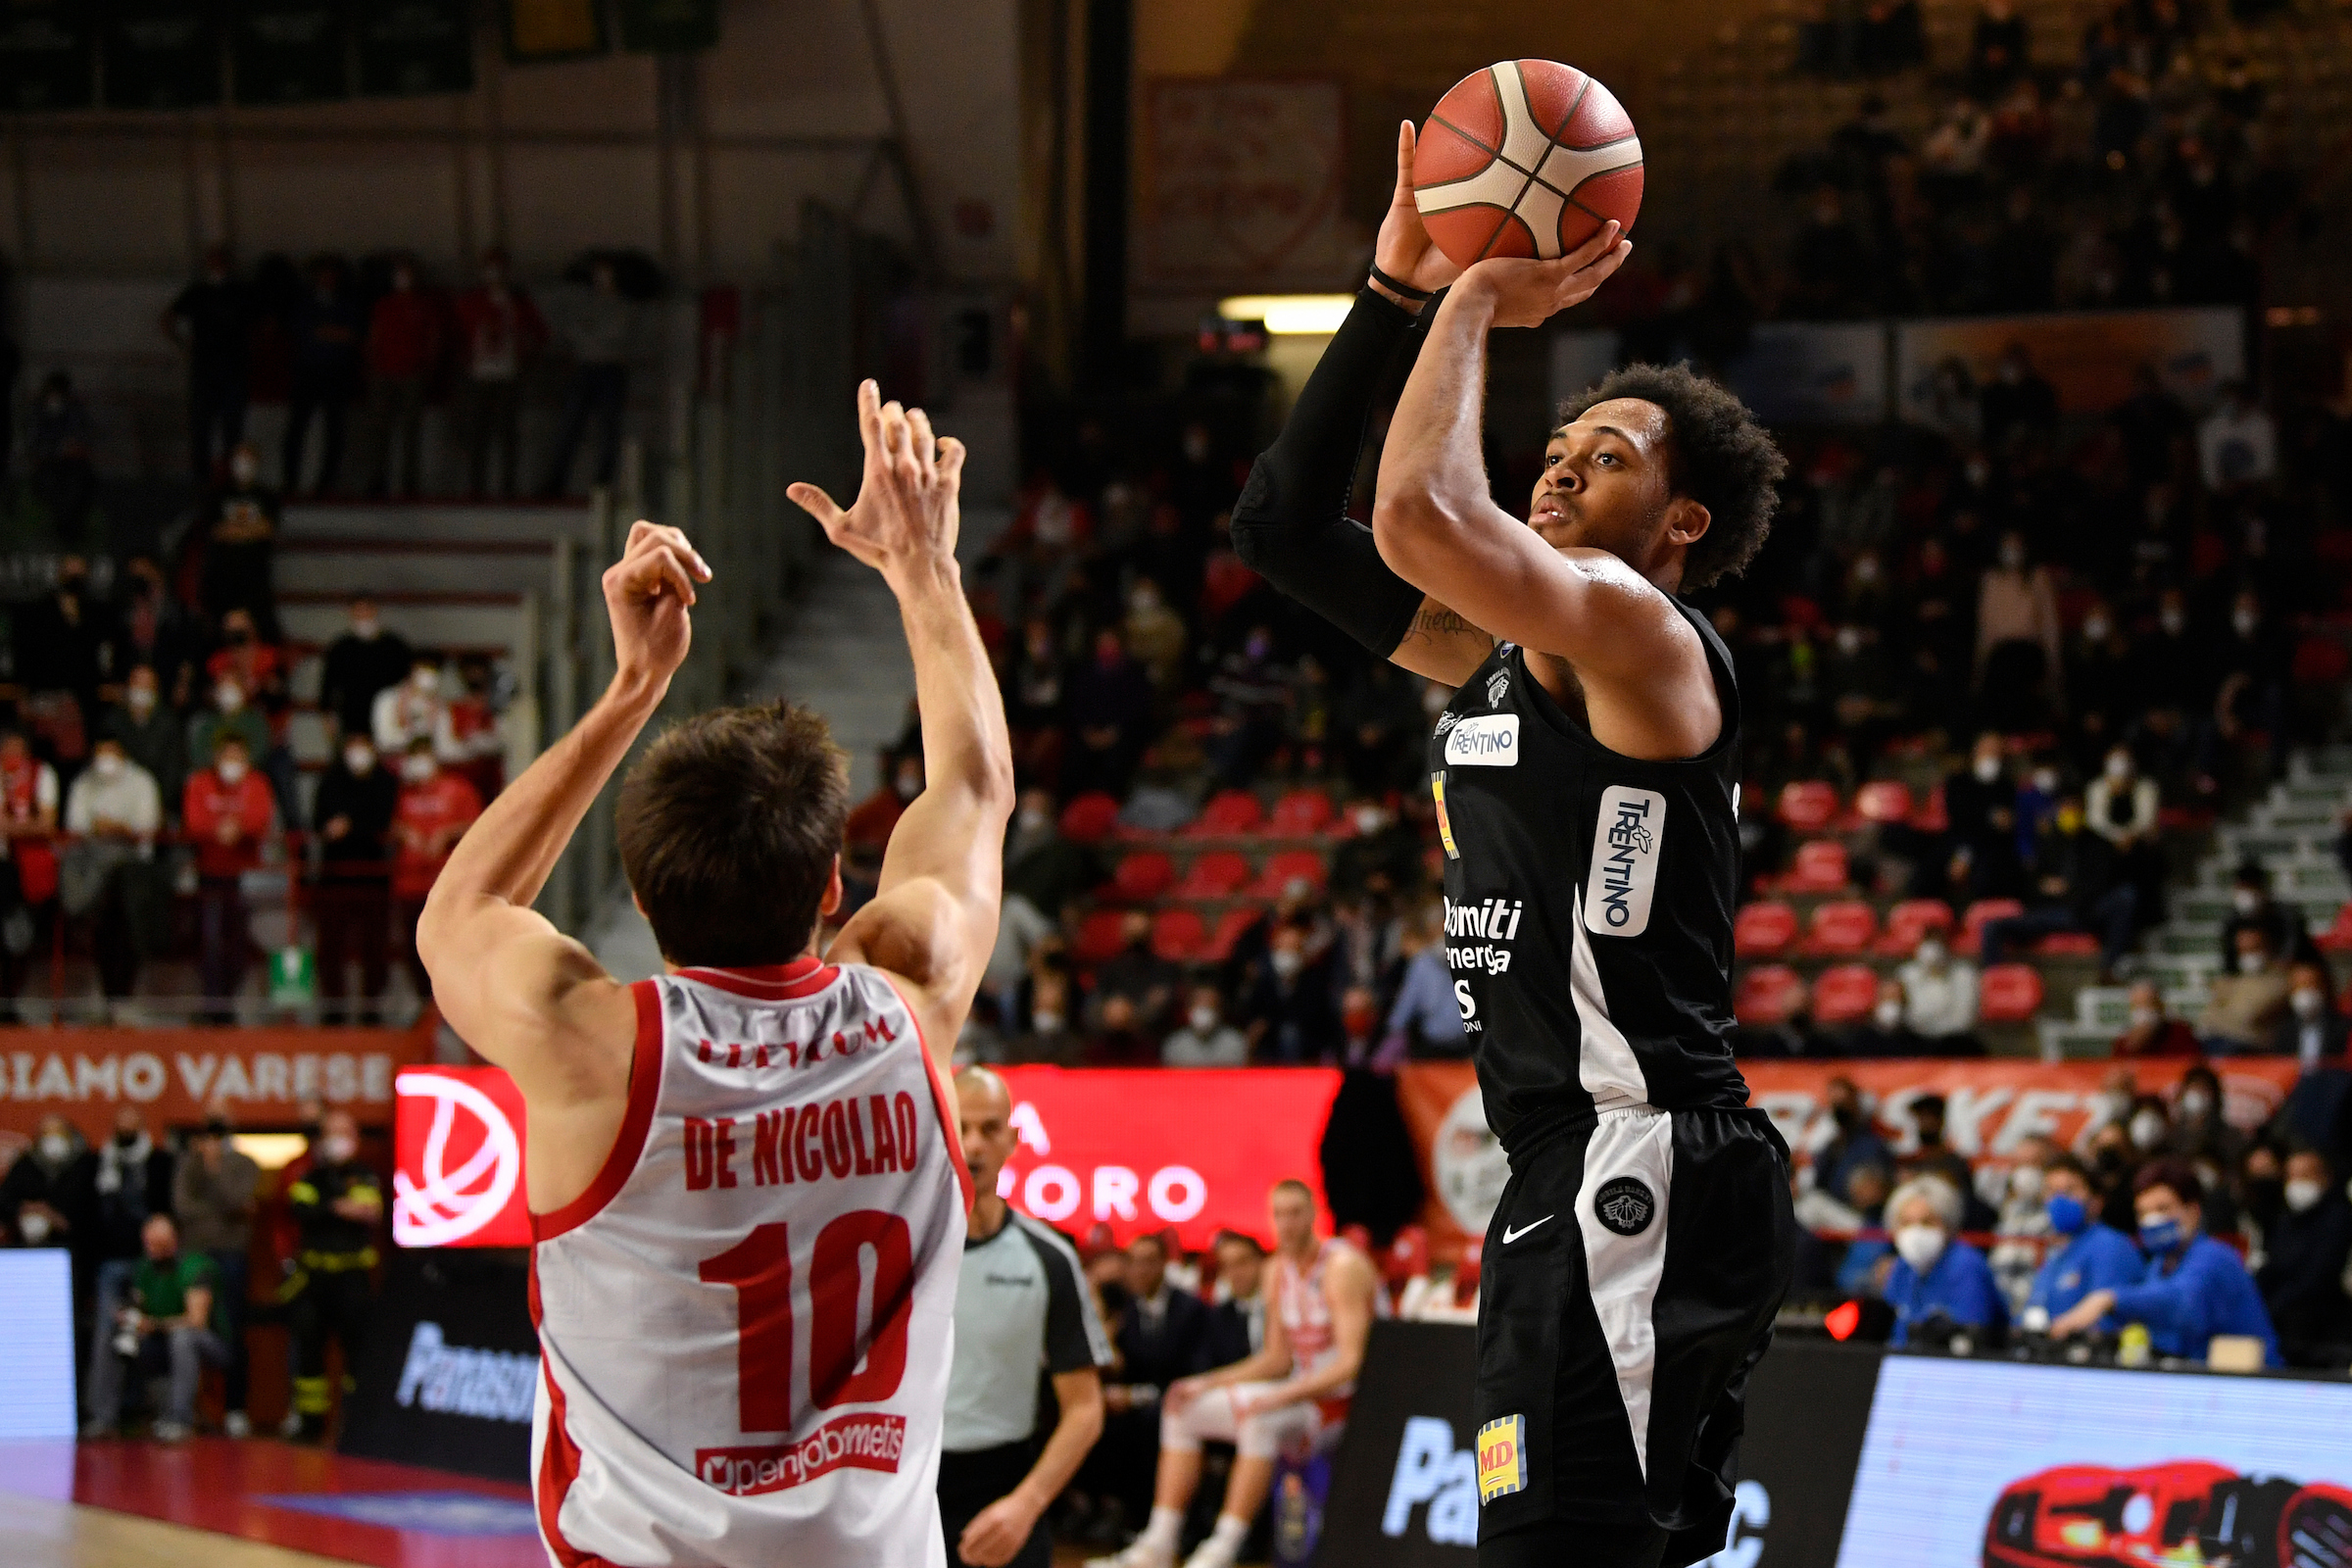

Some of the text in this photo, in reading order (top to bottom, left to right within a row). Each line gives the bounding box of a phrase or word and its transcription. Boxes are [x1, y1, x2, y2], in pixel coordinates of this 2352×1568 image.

[1451, 729, 1512, 755] TRENTINO
[1600, 799, 1650, 927] TRENTINO
[0, 1050, 393, 1102] IAMO VARESE
[684, 1090, 917, 1192] DE NICOLAO
[698, 1208, 915, 1434] 10
[1480, 1440, 1514, 1477] MD
